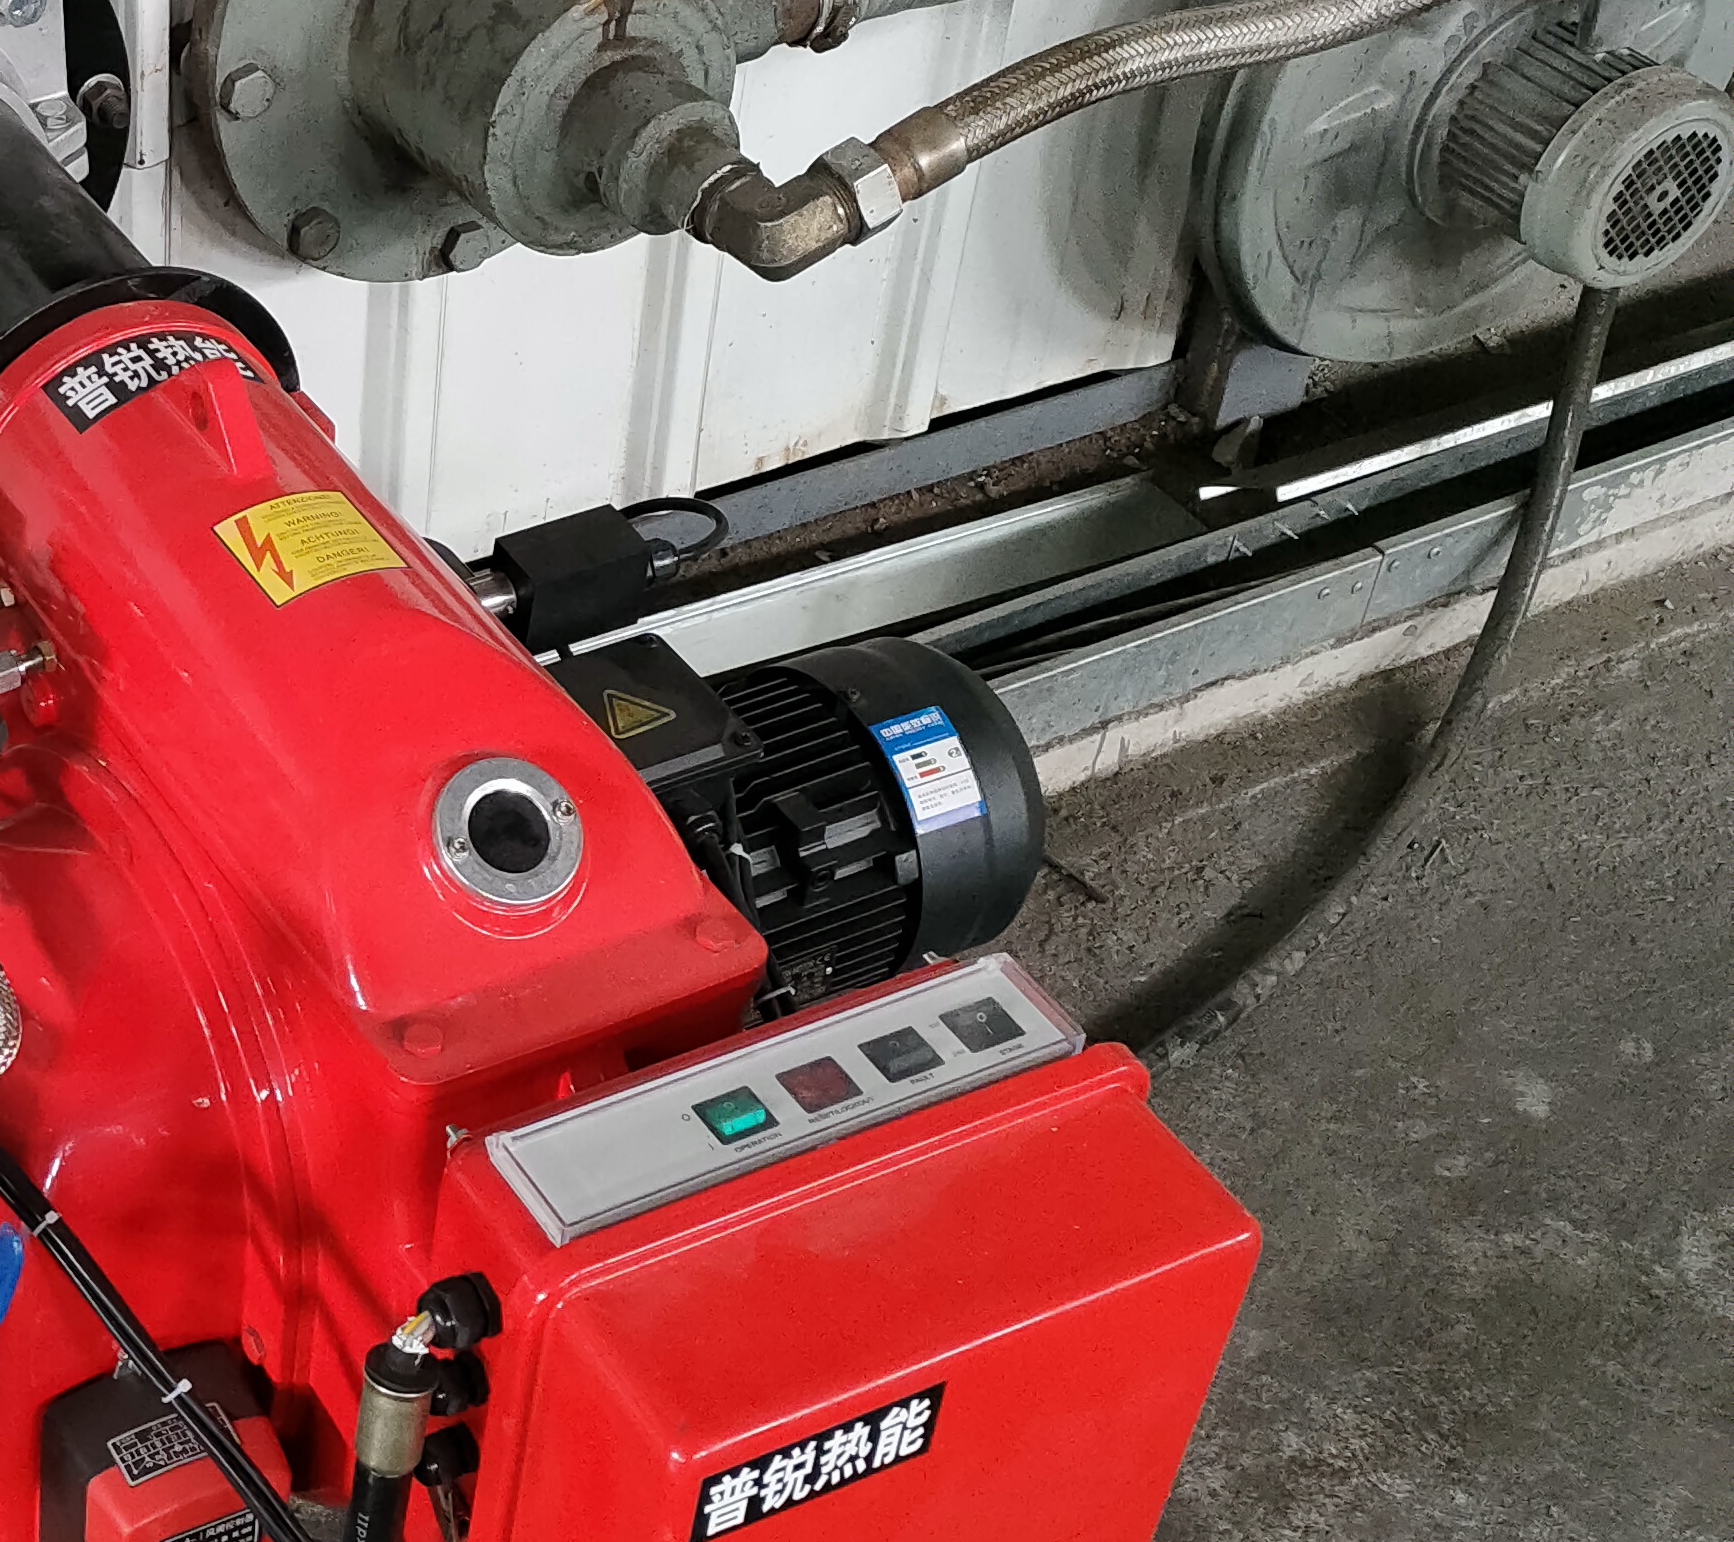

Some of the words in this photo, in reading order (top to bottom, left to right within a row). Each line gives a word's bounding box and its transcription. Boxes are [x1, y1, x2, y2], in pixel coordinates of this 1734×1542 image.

[57, 335, 254, 420] 普锐热能
[284, 511, 342, 528] WARNING!
[300, 529, 359, 546] ACHTUNG!
[316, 547, 369, 564] DANGER!
[733, 1132, 782, 1153] OPERATION
[703, 1397, 932, 1537] 普锐热能
